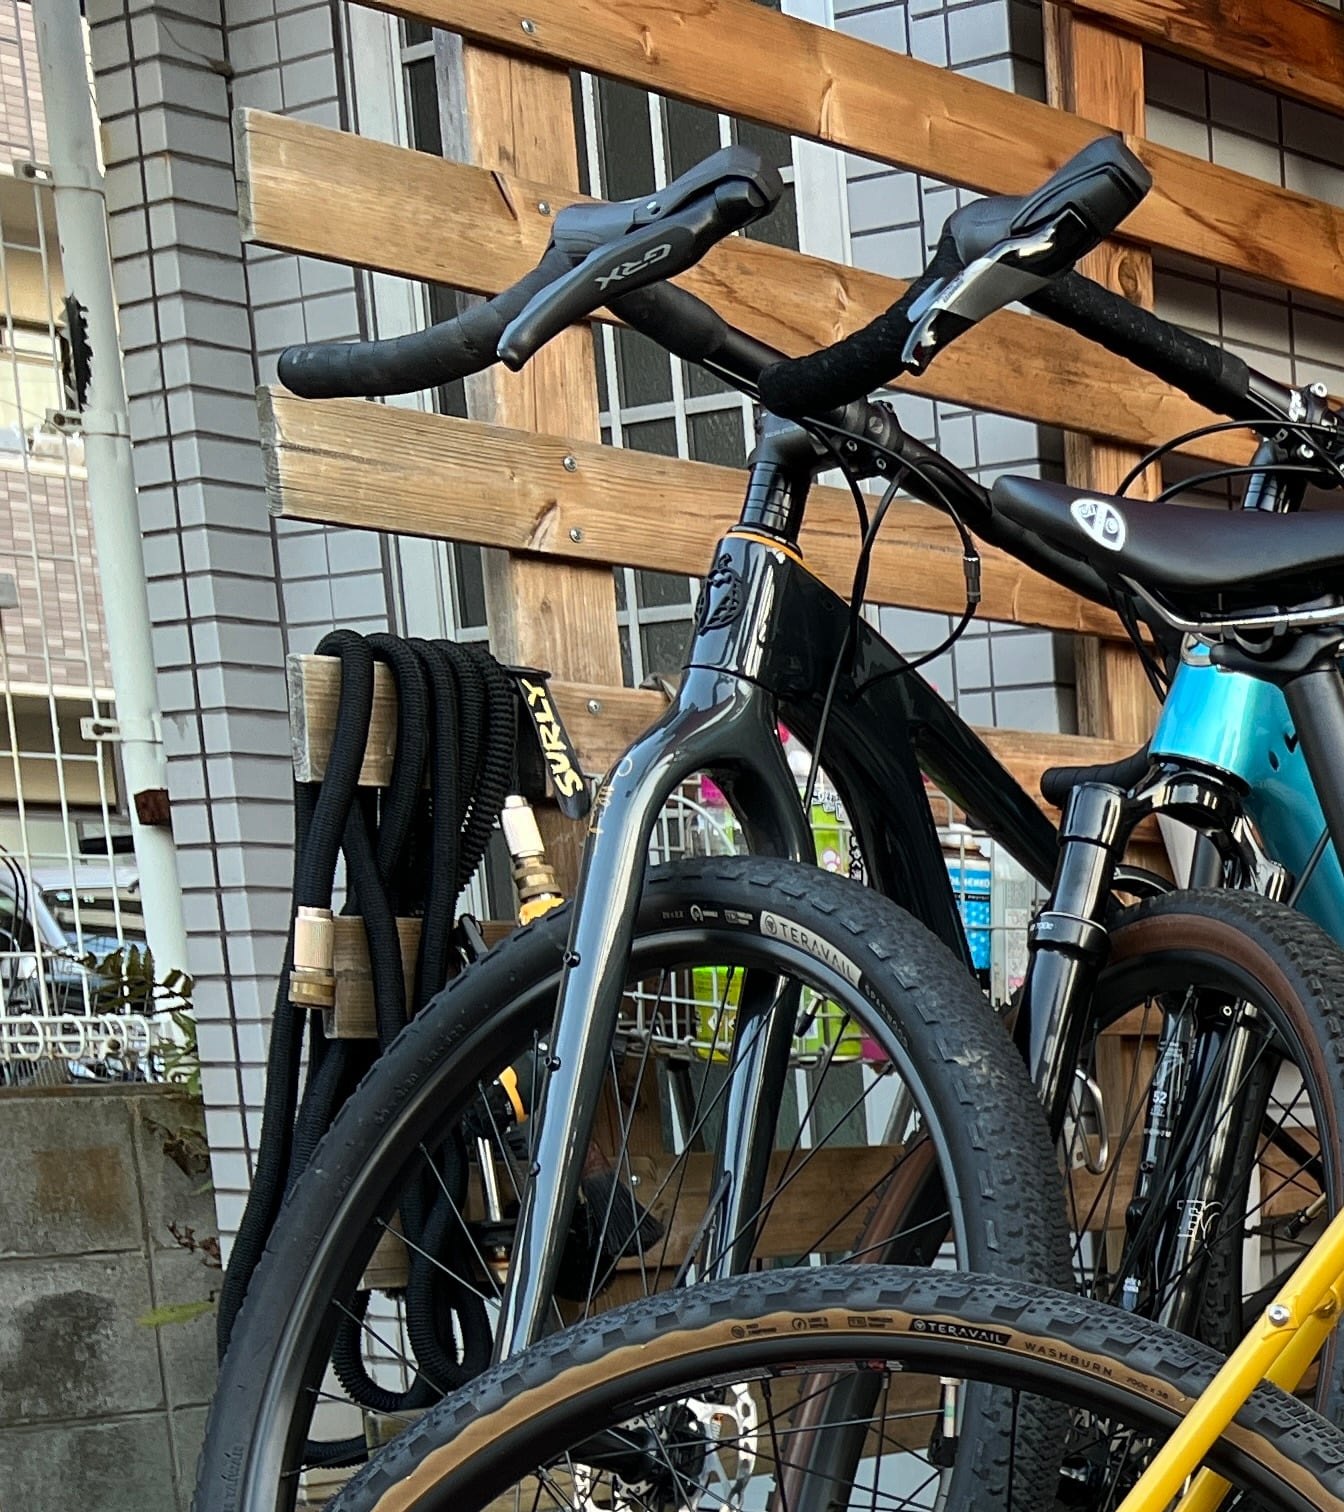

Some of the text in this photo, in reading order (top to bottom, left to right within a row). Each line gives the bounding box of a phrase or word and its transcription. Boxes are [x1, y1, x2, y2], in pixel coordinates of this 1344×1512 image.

[596, 244, 672, 290] GRX
[521, 679, 584, 798] SURLY
[779, 921, 857, 982] TERAVAIL
[927, 1320, 1004, 1345] TERAVAIL
[1024, 1340, 1114, 1378] WASHBURN
